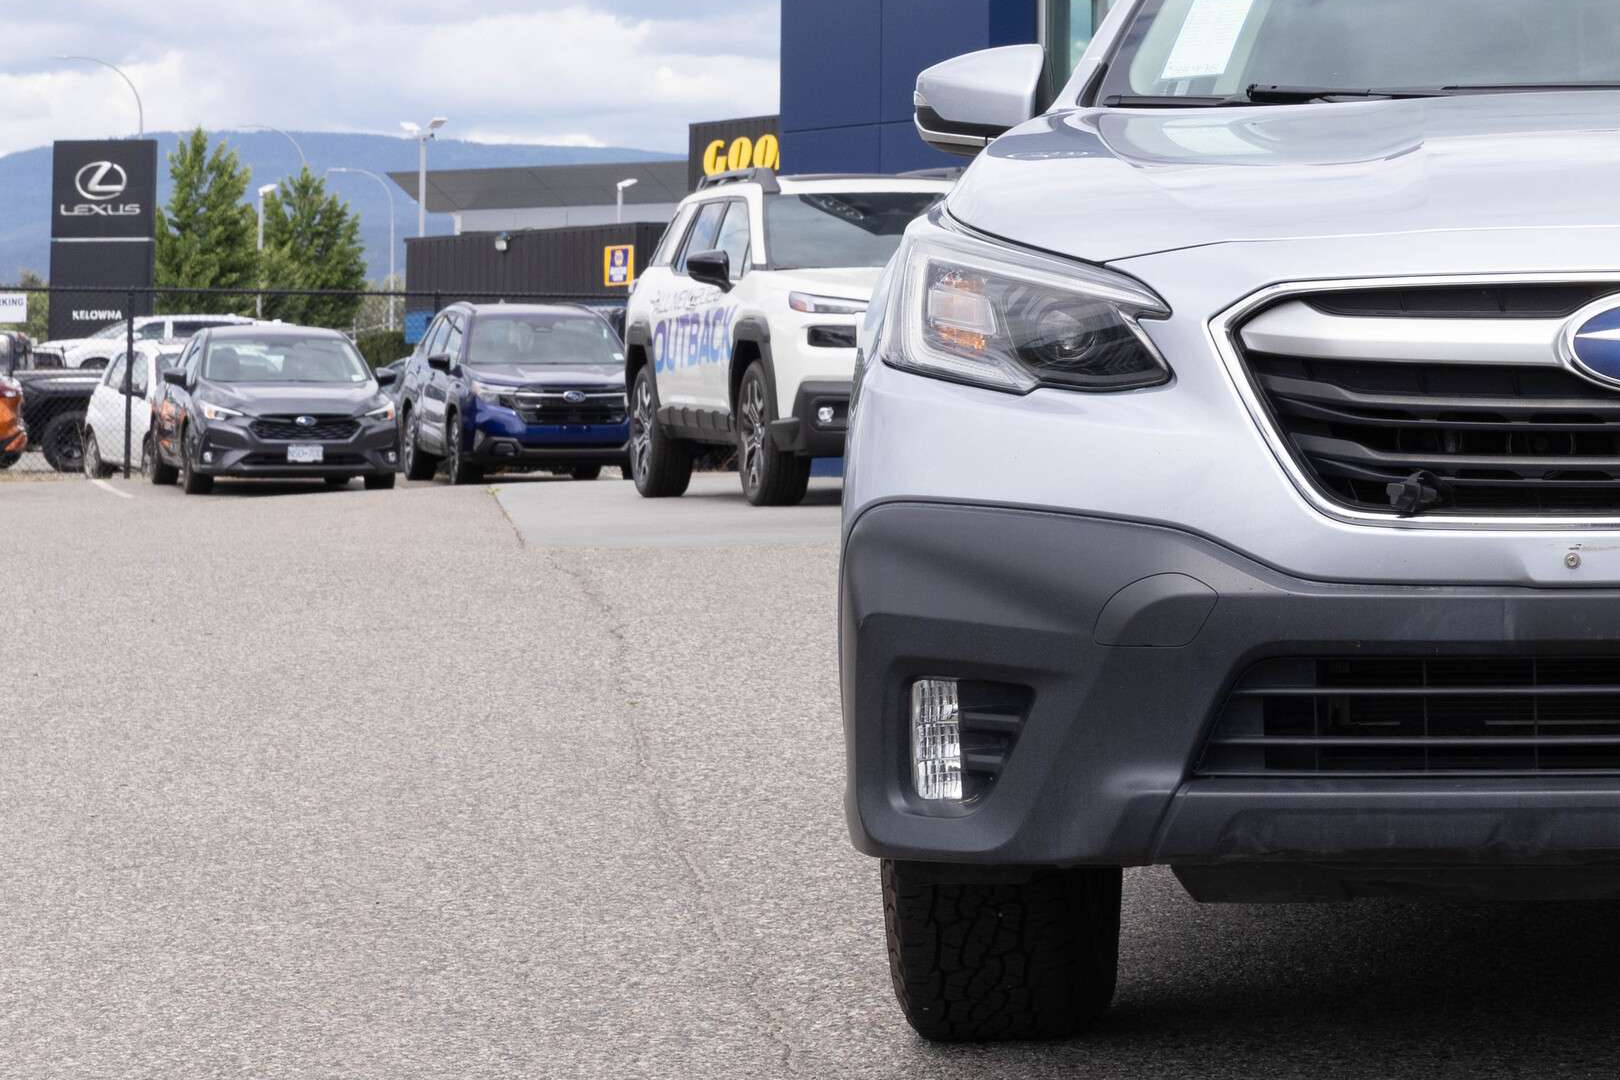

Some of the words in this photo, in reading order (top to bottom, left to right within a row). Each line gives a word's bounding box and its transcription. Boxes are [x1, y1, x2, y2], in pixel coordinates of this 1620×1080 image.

[703, 134, 780, 177] GOO
[60, 204, 141, 216] LEXUS
[0, 297, 24, 307] KING
[72, 309, 122, 321] KELOWNA
[653, 305, 738, 374] OUTBACK
